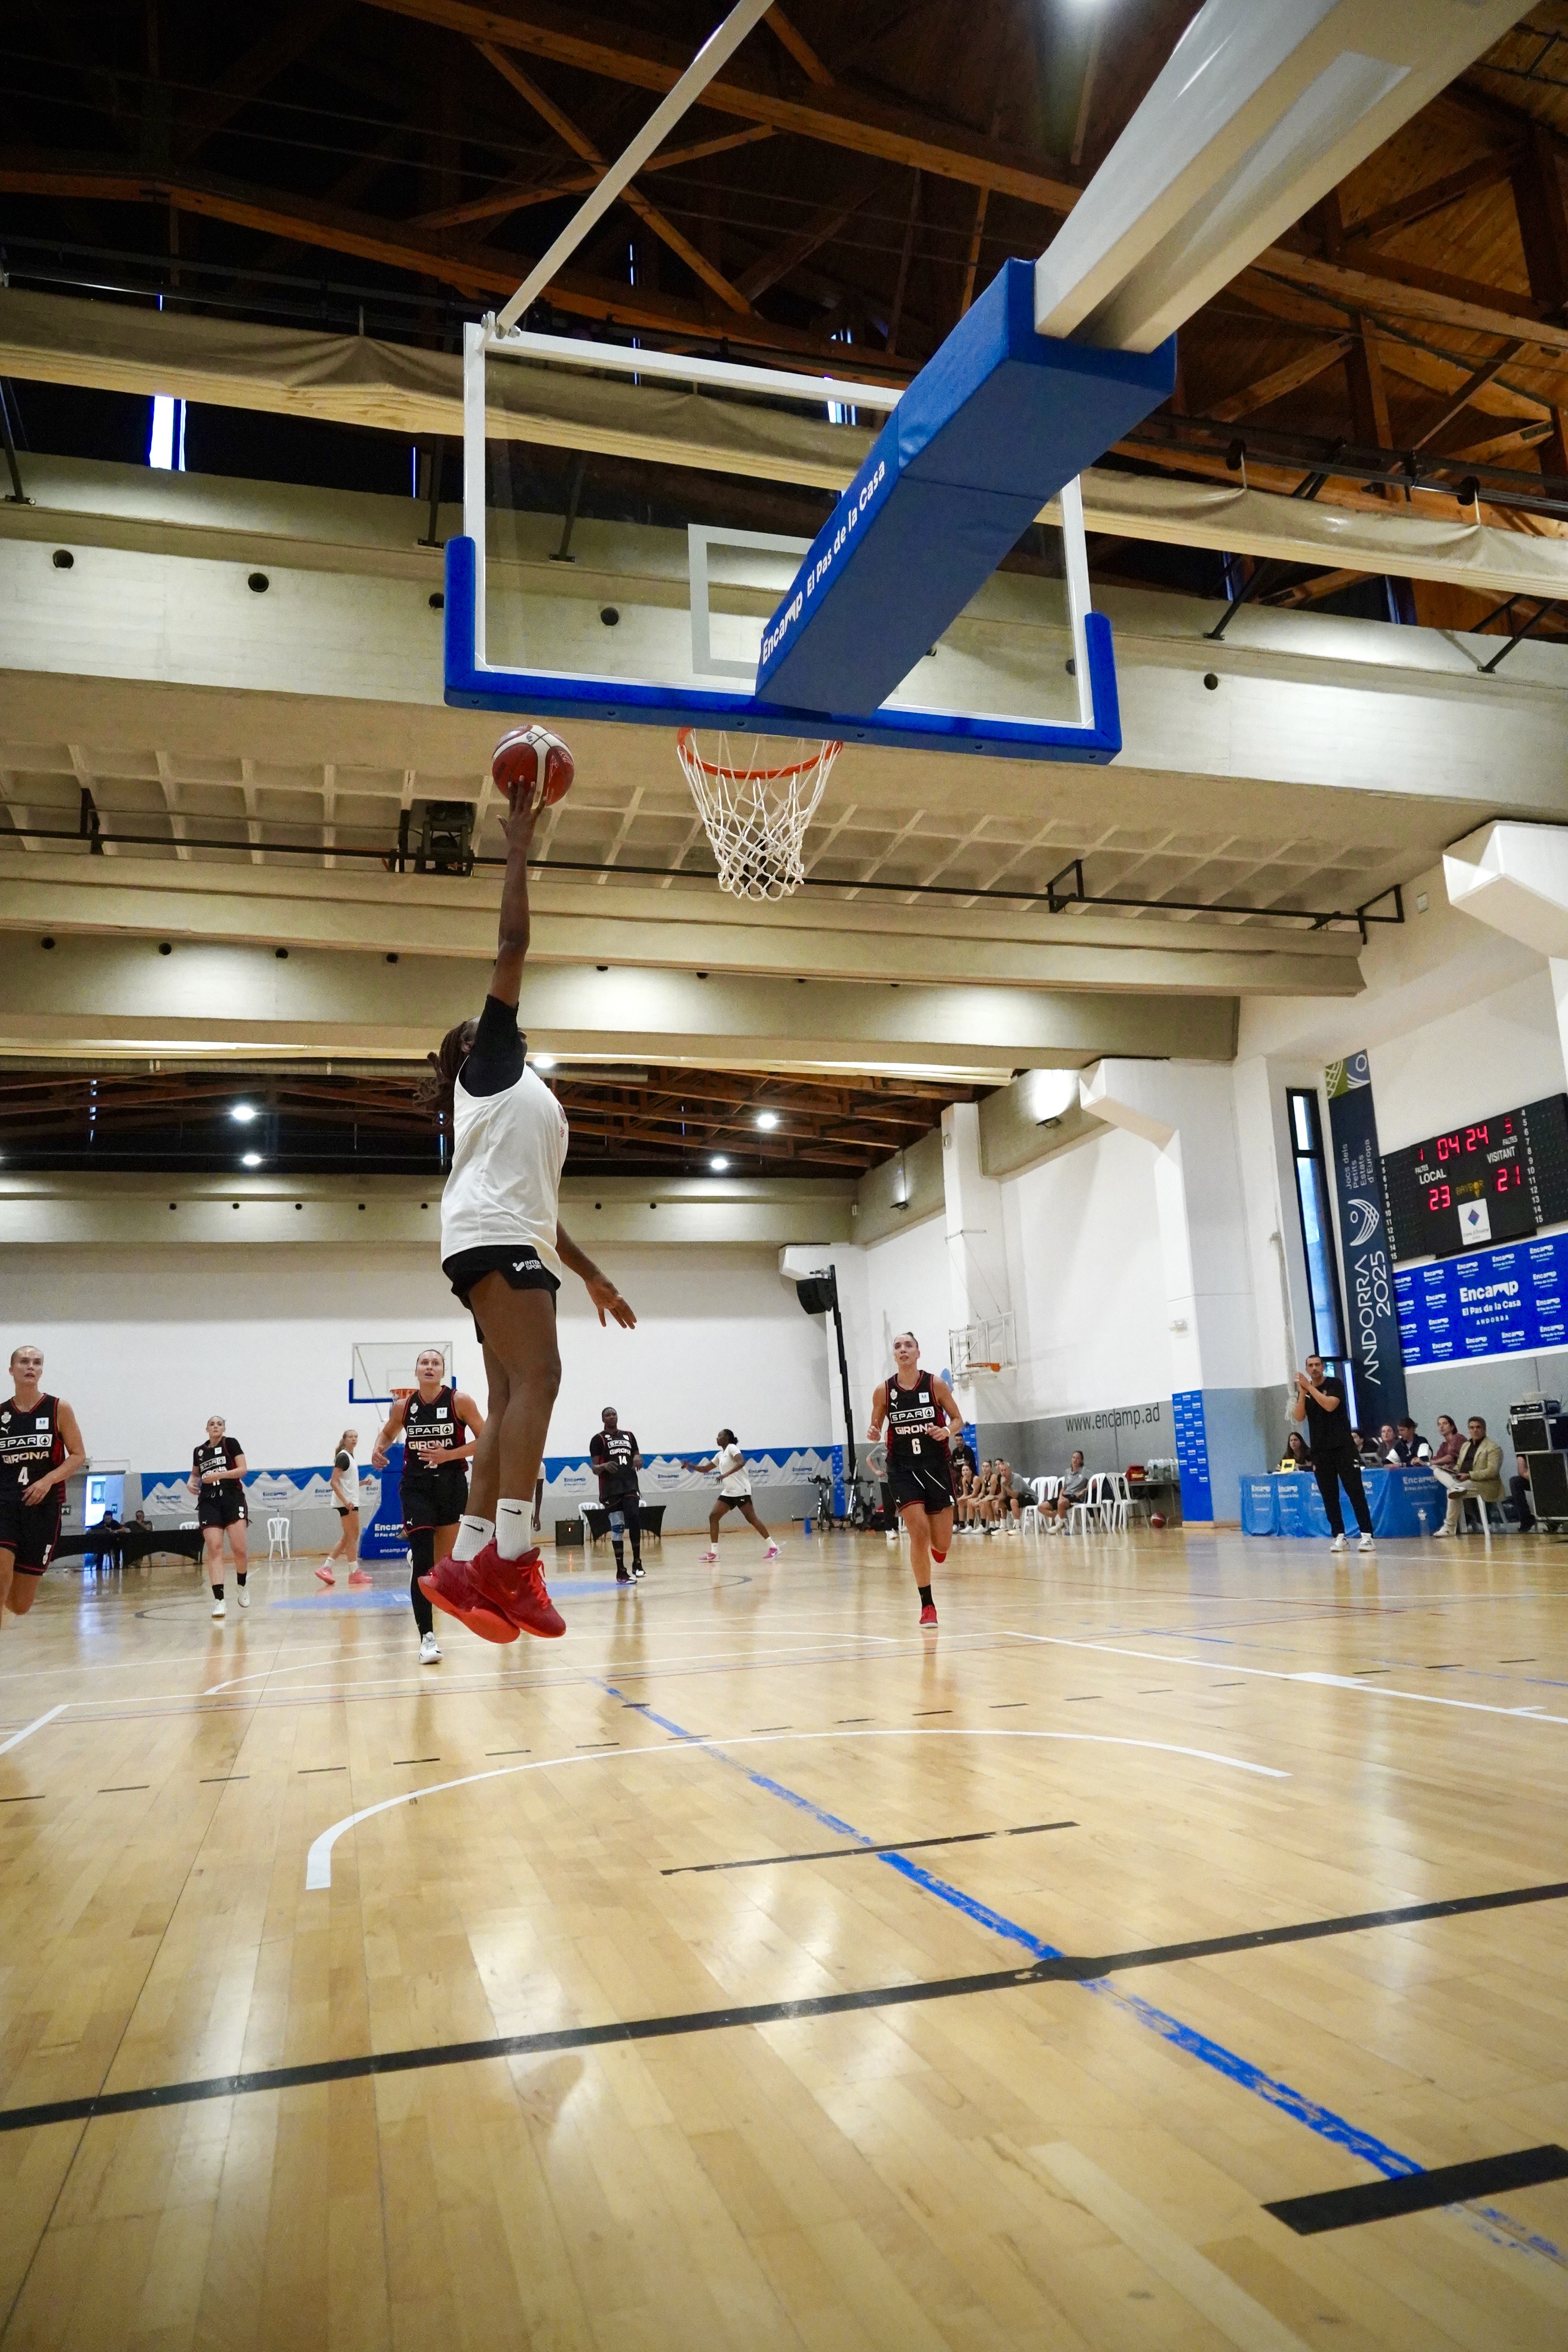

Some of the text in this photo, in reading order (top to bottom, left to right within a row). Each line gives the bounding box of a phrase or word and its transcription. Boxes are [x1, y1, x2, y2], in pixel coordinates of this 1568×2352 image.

[762, 461, 885, 665] Encamp El Pas de la Casa
[1504, 1117, 1512, 1134] 3
[1420, 1148, 1424, 1161] 1
[1486, 1146, 1515, 1163] VISITANT
[1358, 1154, 1367, 1186] Estats
[1419, 1168, 1447, 1184] LOCAL
[1497, 1165, 1521, 1192] 21
[1428, 1185, 1451, 1211] 23
[1535, 1215, 1544, 1223] 15
[1370, 1250, 1391, 1318] 2025
[1459, 1281, 1519, 1303] Encamp
[1462, 1300, 1521, 1316] El Pas de la Casa
[1354, 1254, 1381, 1385] ANDORRA
[1476, 1315, 1509, 1325] ANDORRA
[892, 1411, 923, 1421] SPAR
[1065, 1402, 1160, 1432] www.encamp.ad
[0, 1438, 36, 1448] SPAR
[911, 1438, 921, 1454] 6
[2, 1451, 49, 1464] GIRONA
[618, 1455, 627, 1465] 14
[17, 1466, 29, 1485] 4
